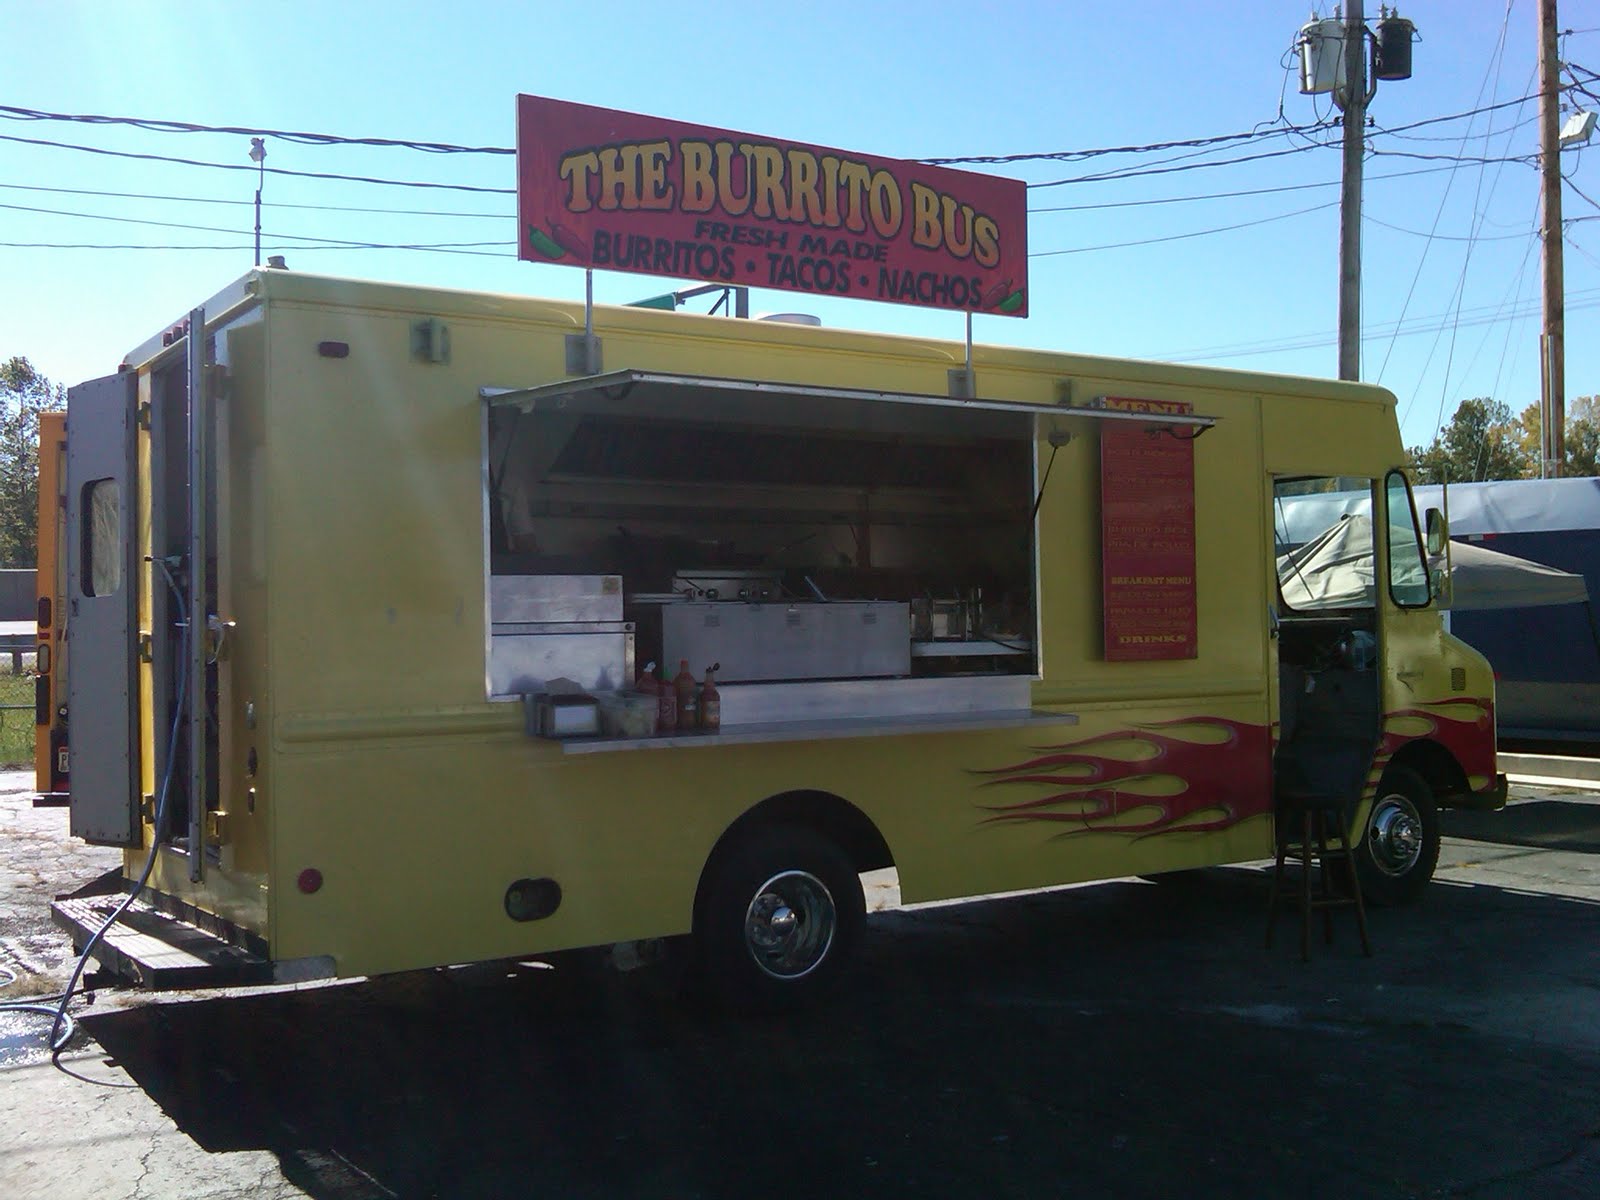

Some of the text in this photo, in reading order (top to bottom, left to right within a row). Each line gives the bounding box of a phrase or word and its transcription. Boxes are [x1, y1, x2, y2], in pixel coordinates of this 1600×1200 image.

[560, 139, 1001, 269] THE BURRITO BUS
[695, 220, 890, 262] FRESH MADE
[592, 230, 982, 307] BURRITOS TACOS NACHOS
[1112, 576, 1191, 585] BREAKFAST MENU
[1120, 635, 1186, 643] DRINKS
